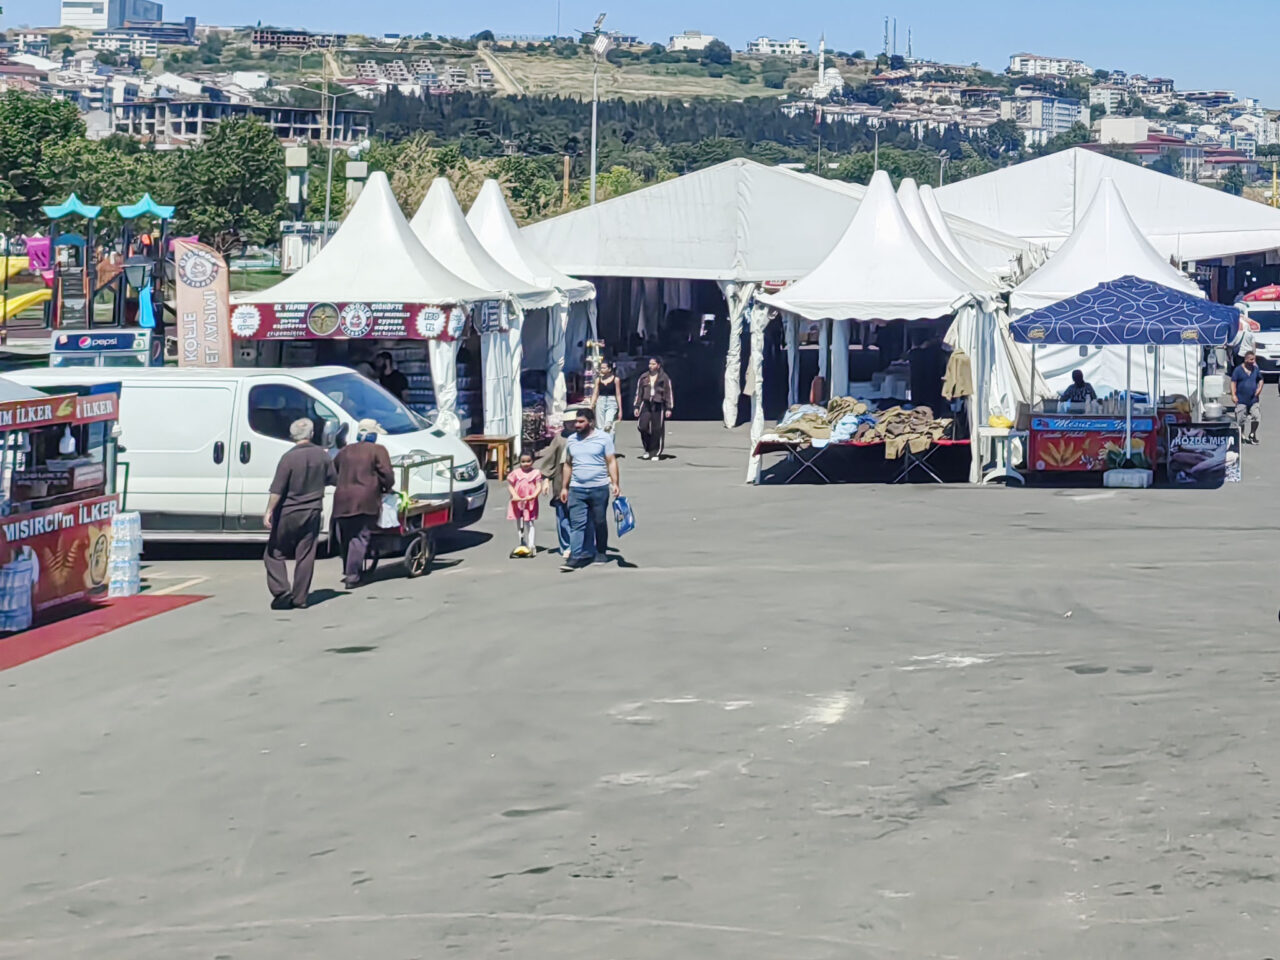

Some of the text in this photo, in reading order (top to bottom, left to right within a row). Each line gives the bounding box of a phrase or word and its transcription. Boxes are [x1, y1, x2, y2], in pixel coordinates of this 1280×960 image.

[92, 337, 118, 346] pepsi
[16, 405, 52, 424] İLKER
[83, 400, 113, 418] İLKER
[78, 500, 118, 525] İLKER
